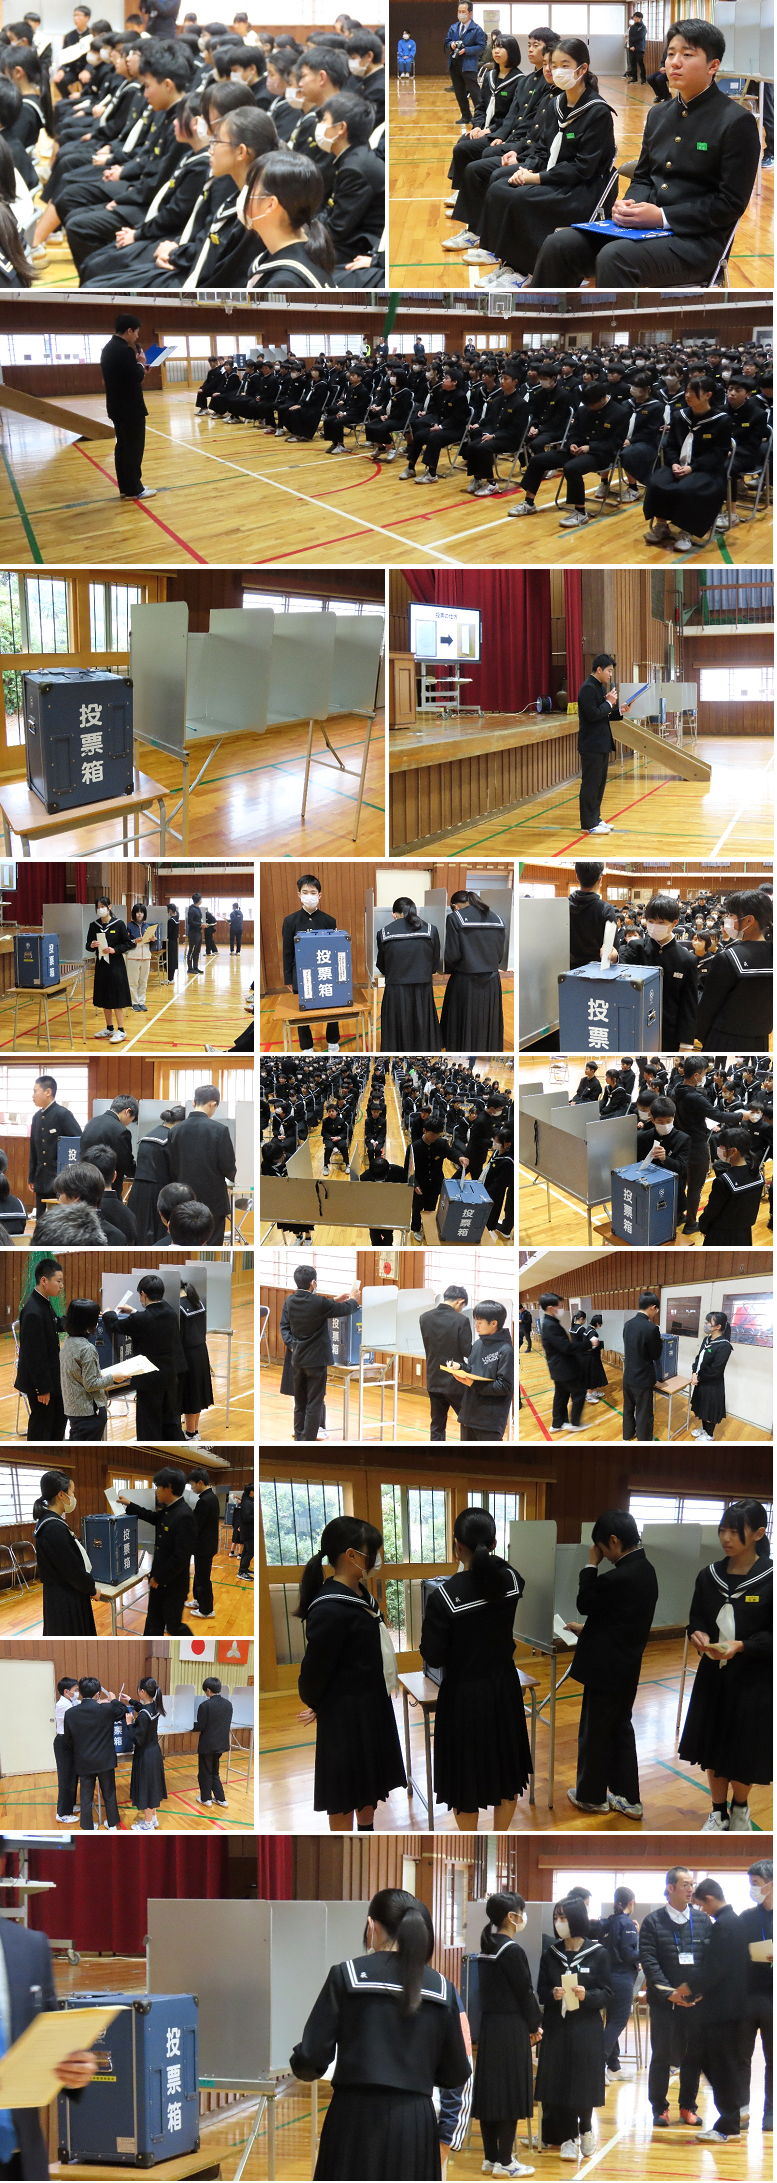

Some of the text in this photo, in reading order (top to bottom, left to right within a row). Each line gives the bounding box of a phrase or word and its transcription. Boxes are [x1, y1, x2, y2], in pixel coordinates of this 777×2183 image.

[79, 703, 104, 785] 投票箱
[316, 949, 333, 998] 投票箱
[587, 998, 609, 1050] 投票
[68, 1148, 77, 1166] 投
[457, 1208, 475, 1237] 投票箱
[623, 1188, 633, 1235] 投票箱
[332, 1317, 340, 1355] 投票箱
[123, 1528, 131, 1570] 投票箱
[166, 2027, 182, 2133] 投票箱
